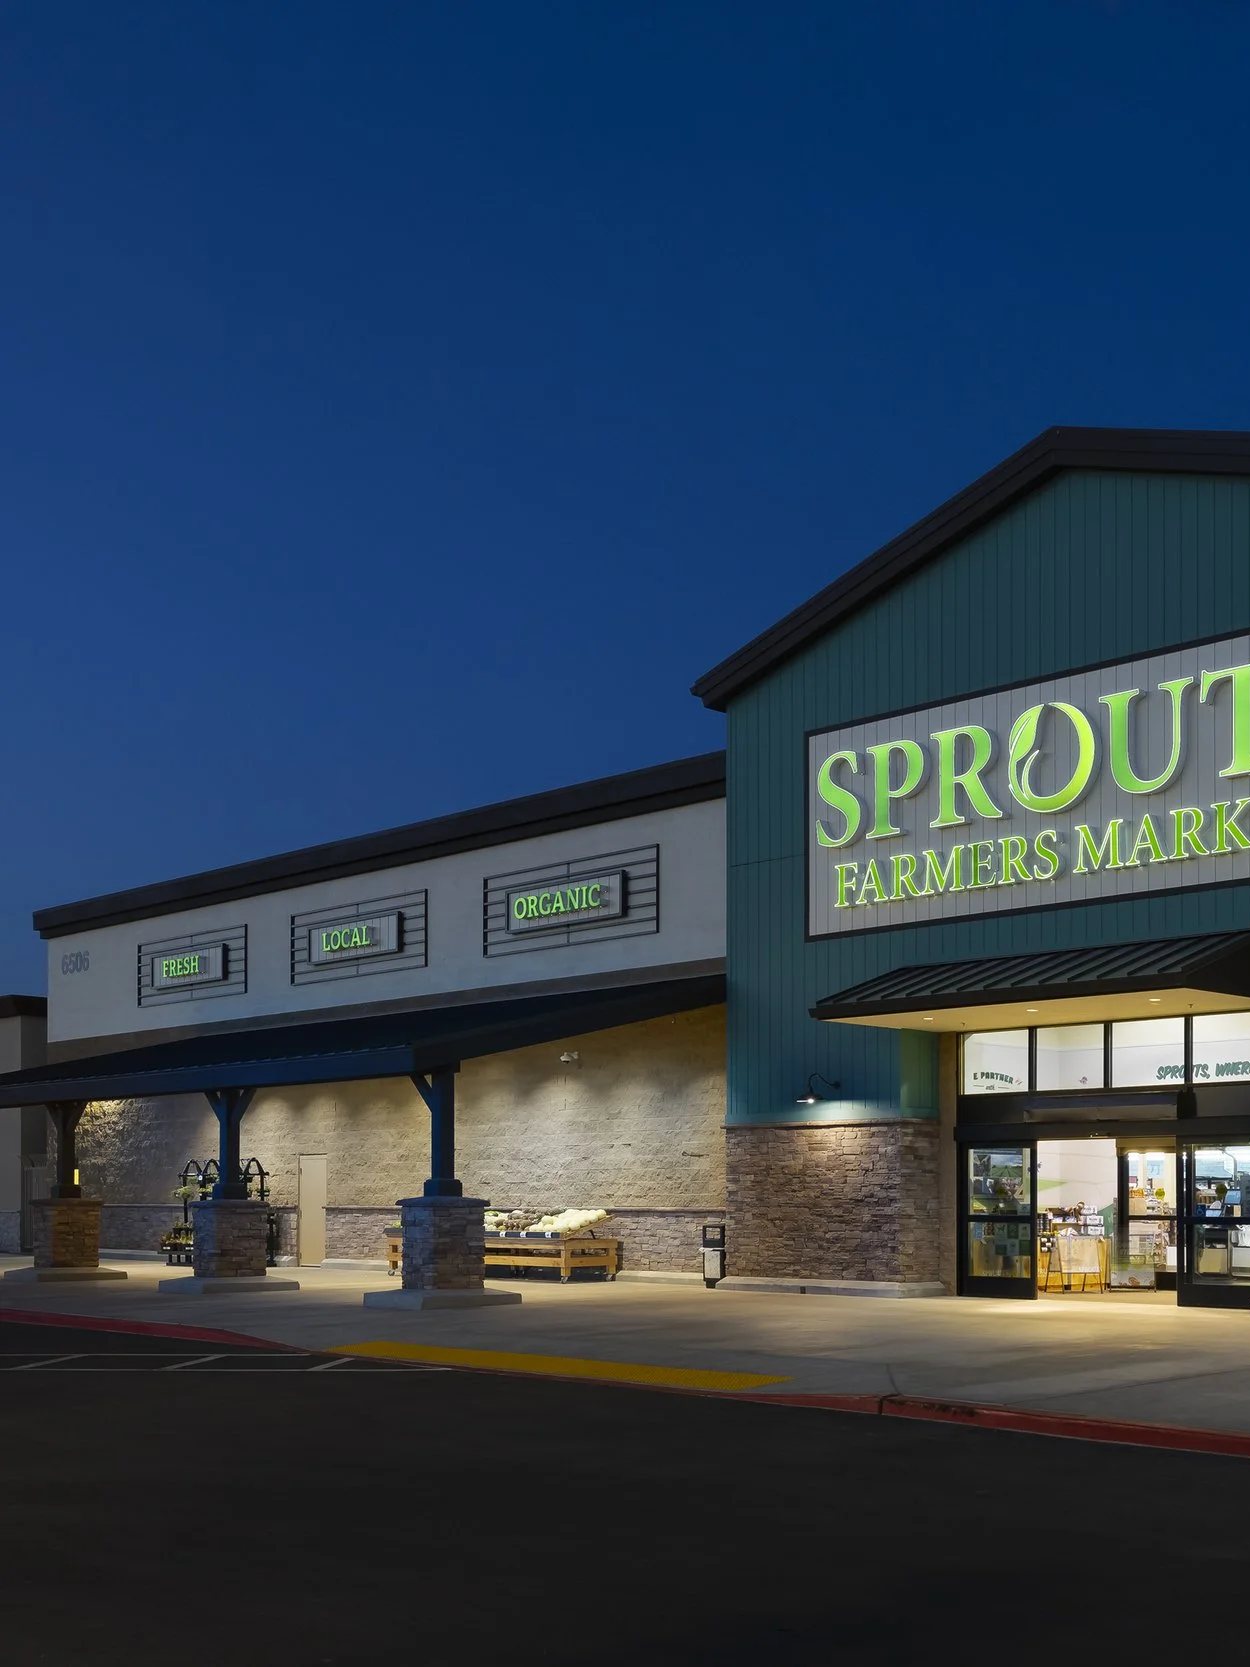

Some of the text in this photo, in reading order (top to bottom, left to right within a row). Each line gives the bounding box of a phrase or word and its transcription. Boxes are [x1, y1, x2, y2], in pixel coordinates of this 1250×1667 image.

[835, 830, 1060, 907] FARMERS
[514, 884, 602, 919] ORGANIC
[322, 926, 370, 952] LOCAL
[162, 956, 199, 977] FRESH
[981, 1072, 1014, 1084] PARTNER
